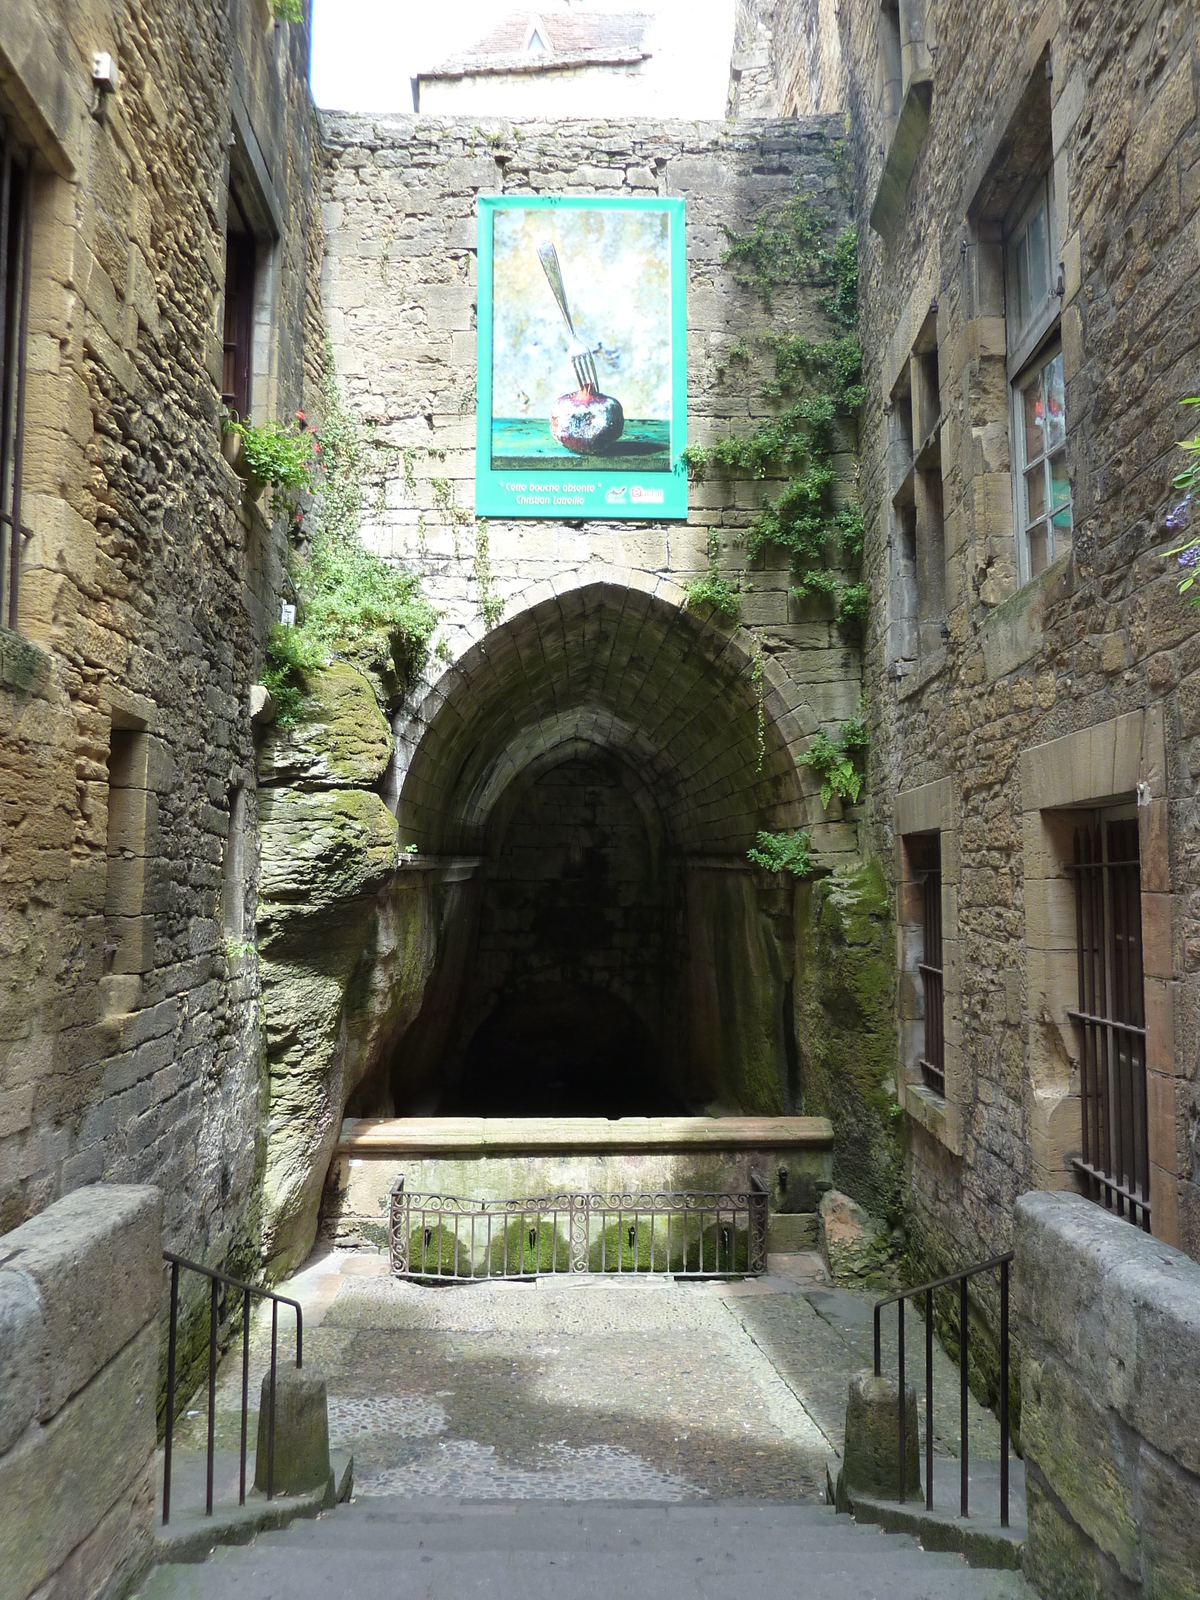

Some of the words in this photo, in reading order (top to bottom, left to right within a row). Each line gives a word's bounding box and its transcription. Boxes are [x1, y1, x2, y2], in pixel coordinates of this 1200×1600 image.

[505, 482, 527, 492] Cette
[529, 482, 560, 492] bouche
[562, 483, 595, 493] absente
[515, 495, 550, 505] Christian
[552, 495, 585, 505] Latreille
